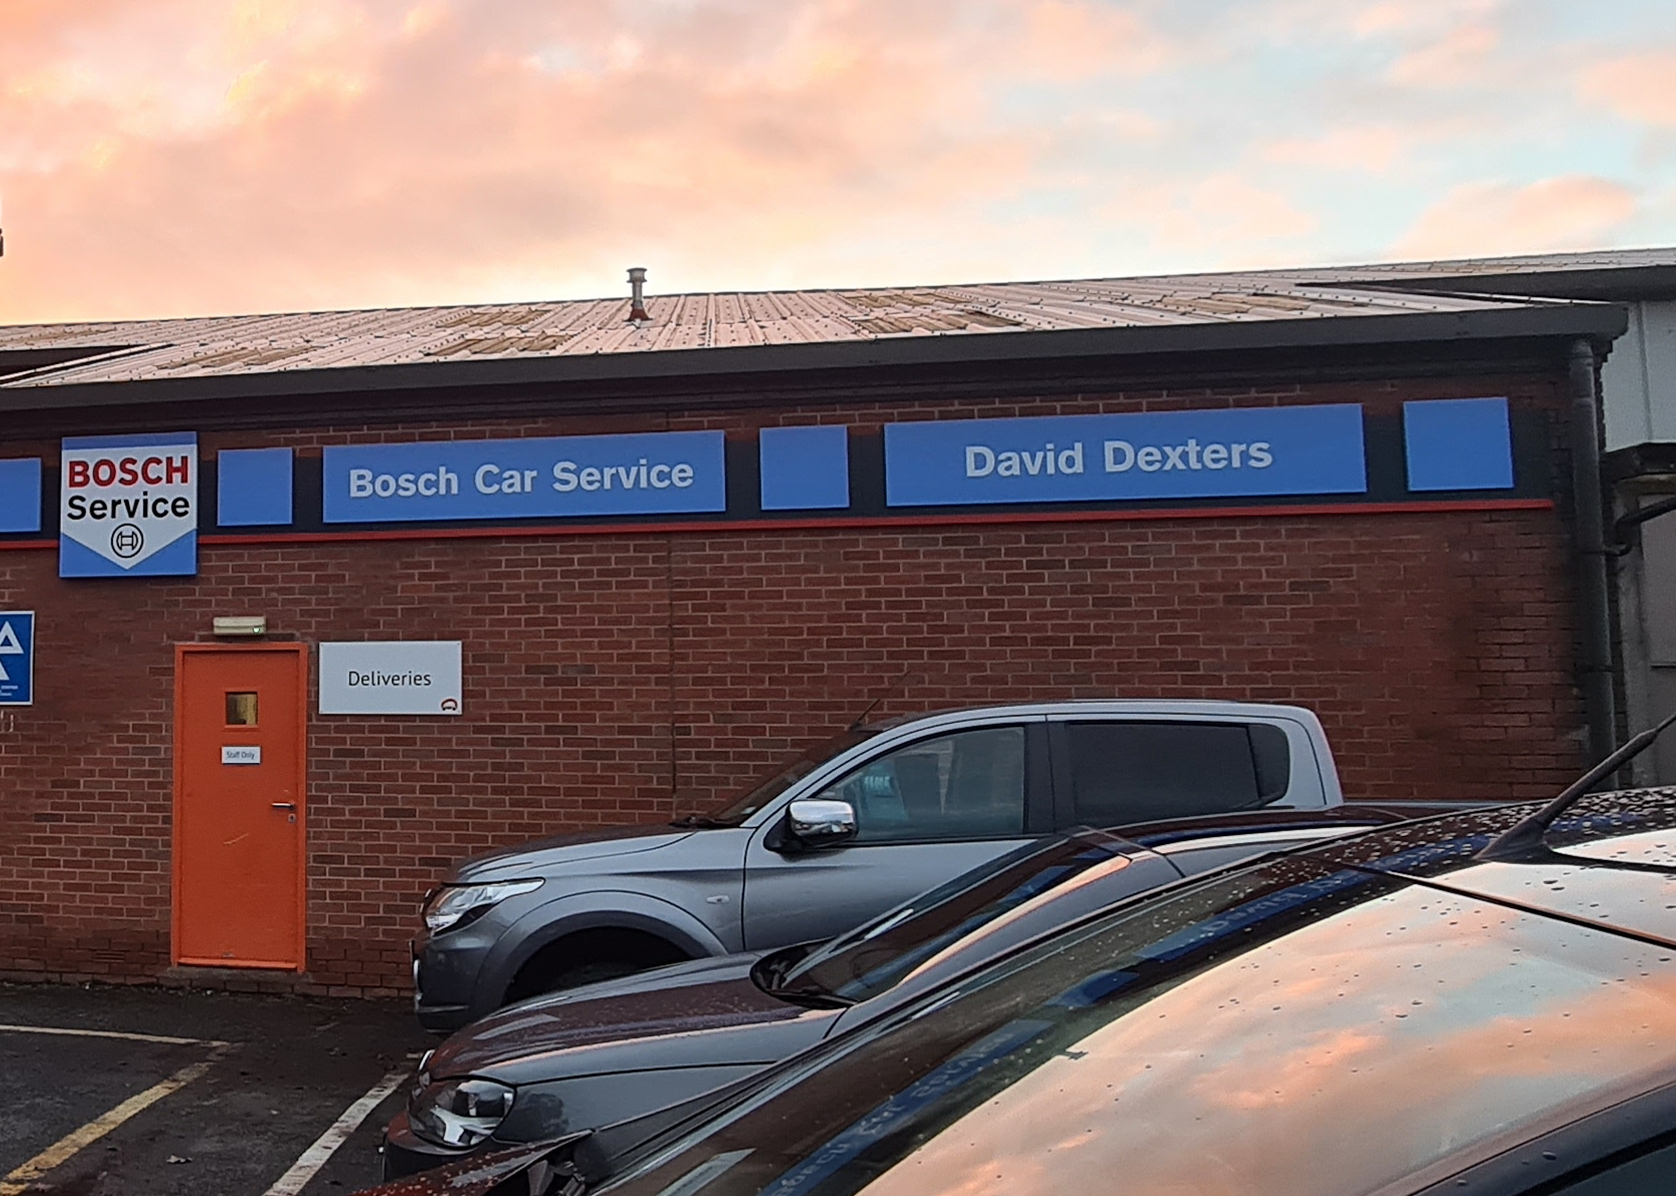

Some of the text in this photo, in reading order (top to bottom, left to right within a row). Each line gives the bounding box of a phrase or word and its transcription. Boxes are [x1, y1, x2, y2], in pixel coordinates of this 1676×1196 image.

[68, 455, 189, 488] BOSCH
[965, 438, 1273, 478] David Dexters
[349, 458, 694, 498] Bosch Car Service
[67, 491, 190, 520] Service
[348, 670, 432, 687] Deliveries
